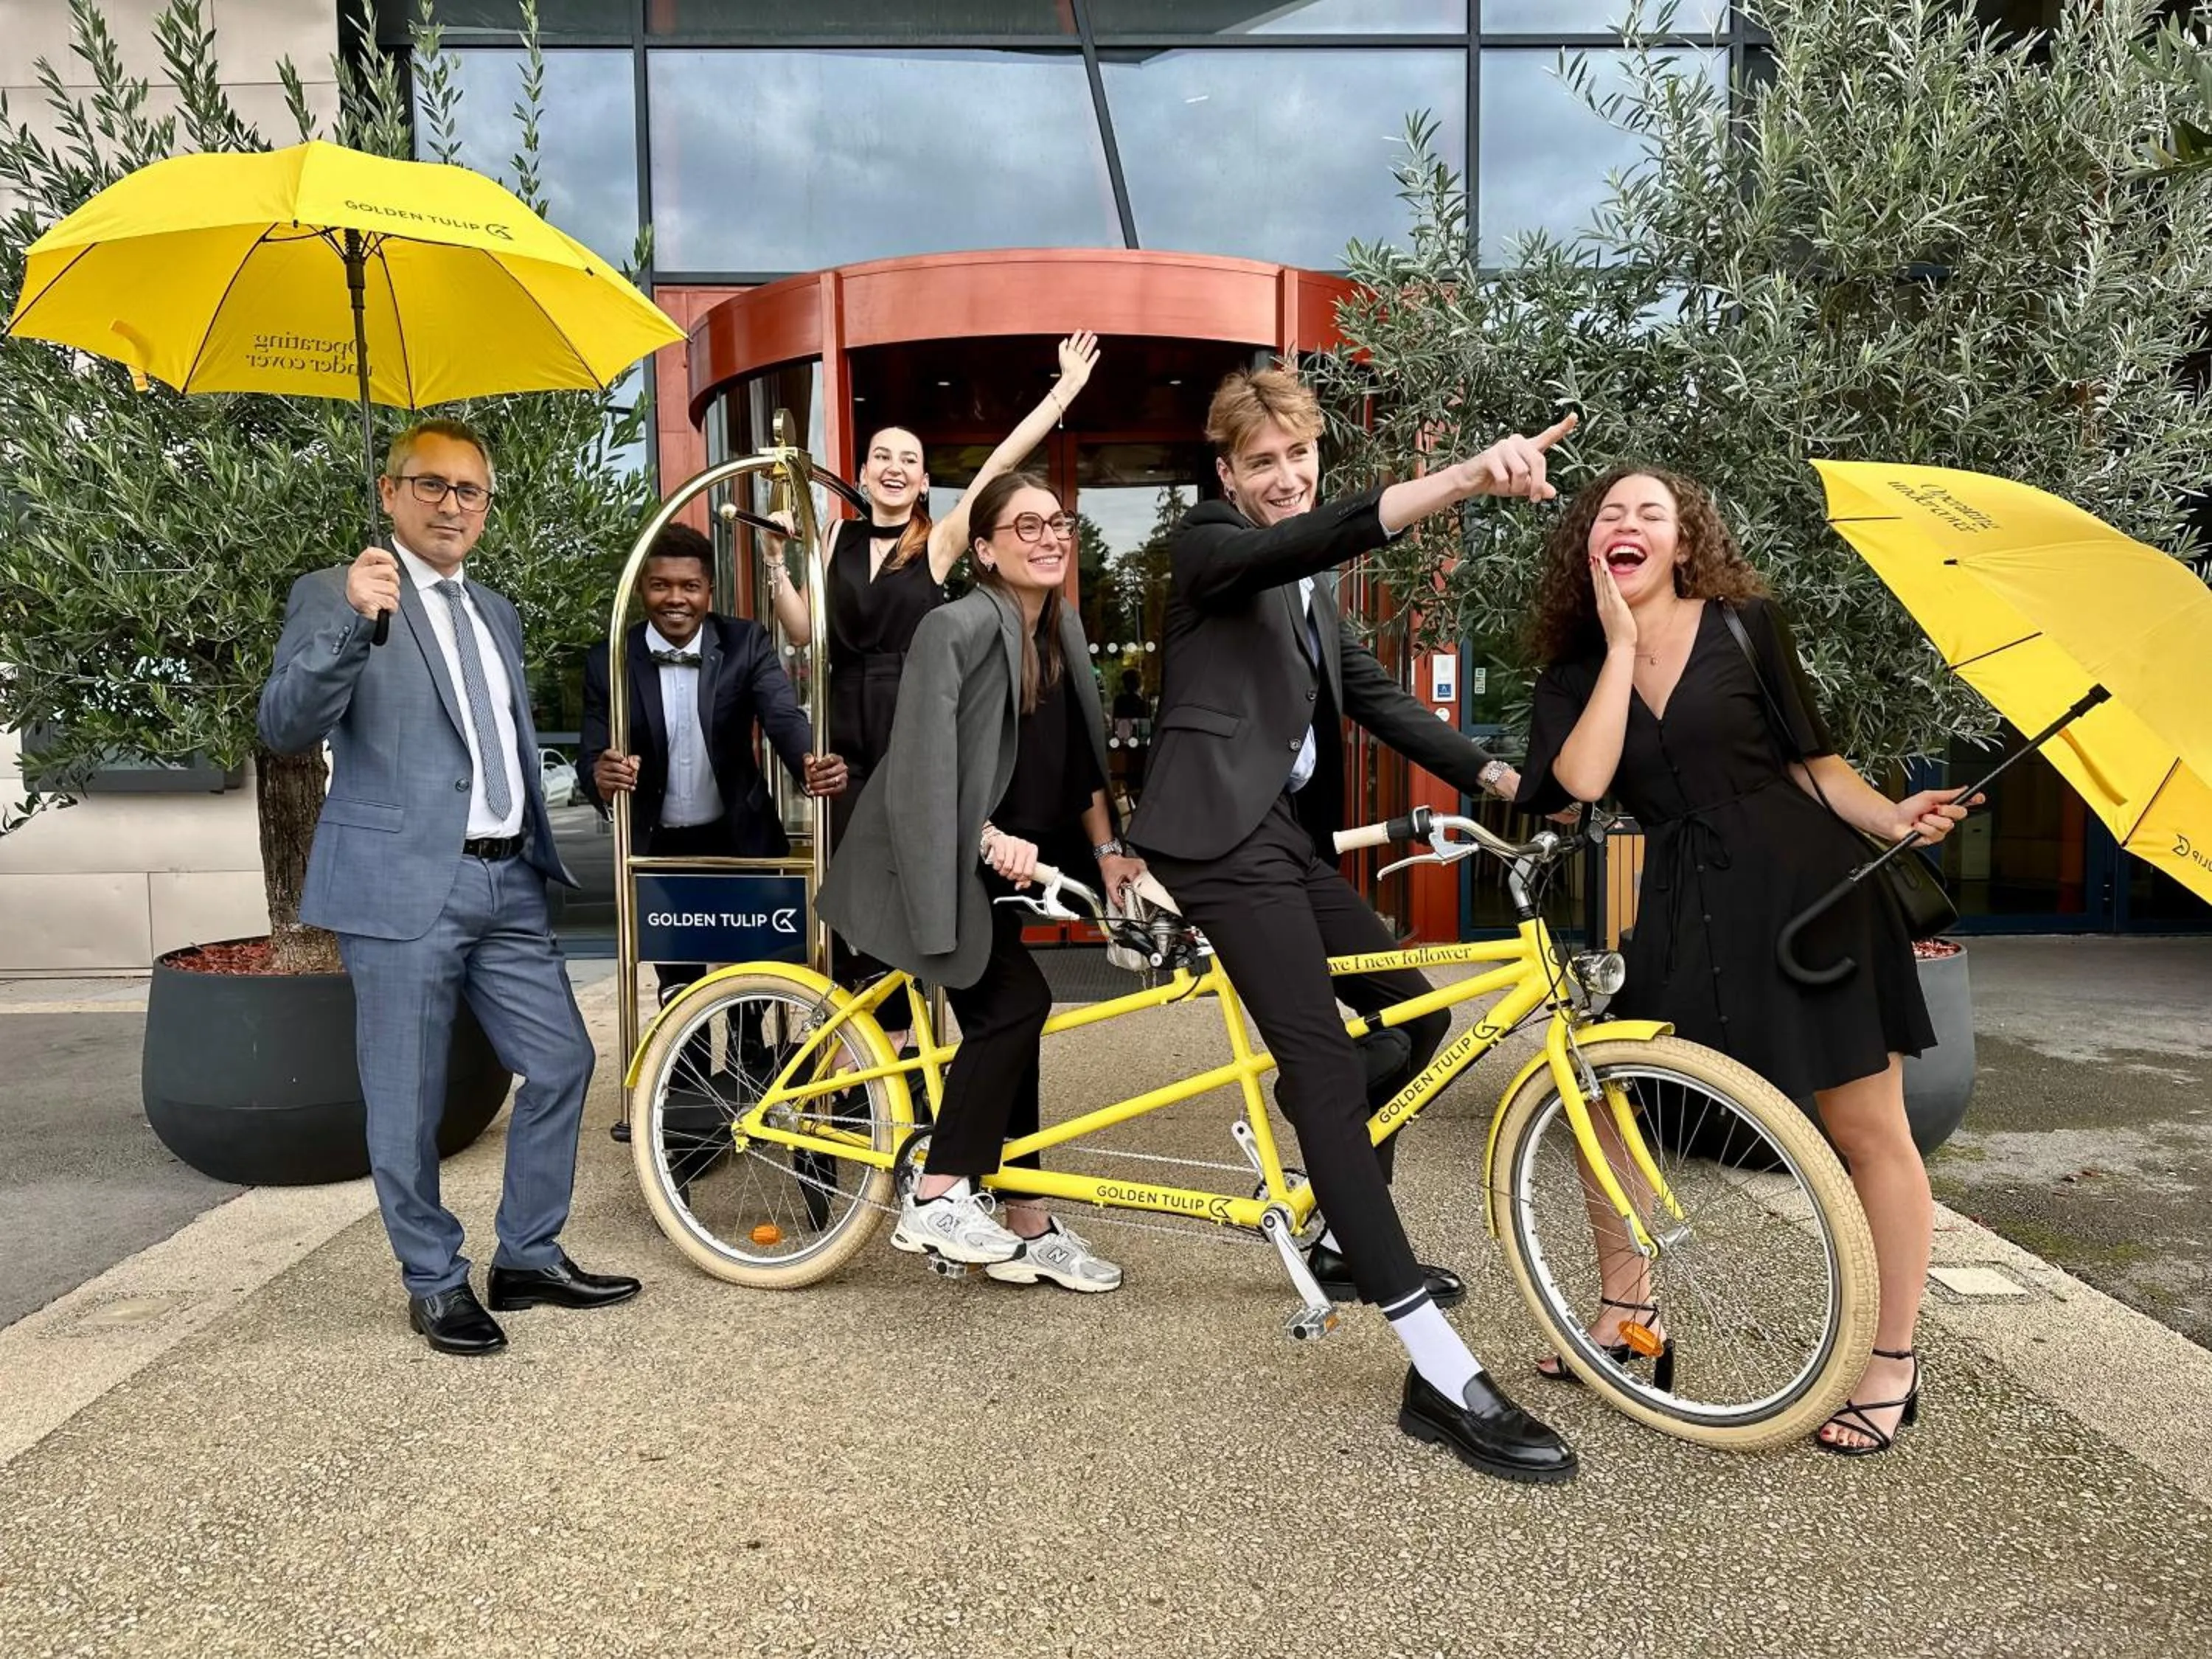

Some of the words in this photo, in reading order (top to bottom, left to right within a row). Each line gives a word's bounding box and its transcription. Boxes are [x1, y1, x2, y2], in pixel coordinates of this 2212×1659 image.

[344, 200, 422, 221] GOLDEN
[428, 215, 480, 230] TULIP
[647, 912, 716, 927] GOLDEN
[720, 913, 768, 927] TULIP
[1364, 954, 1399, 969] new
[1402, 947, 1472, 965] follower
[1379, 1072, 1434, 1124] GOLDEN
[1432, 1037, 1471, 1075] TULIP
[1096, 1185, 1158, 1204] GOLDEN
[1162, 1194, 1204, 1211] TULIP
